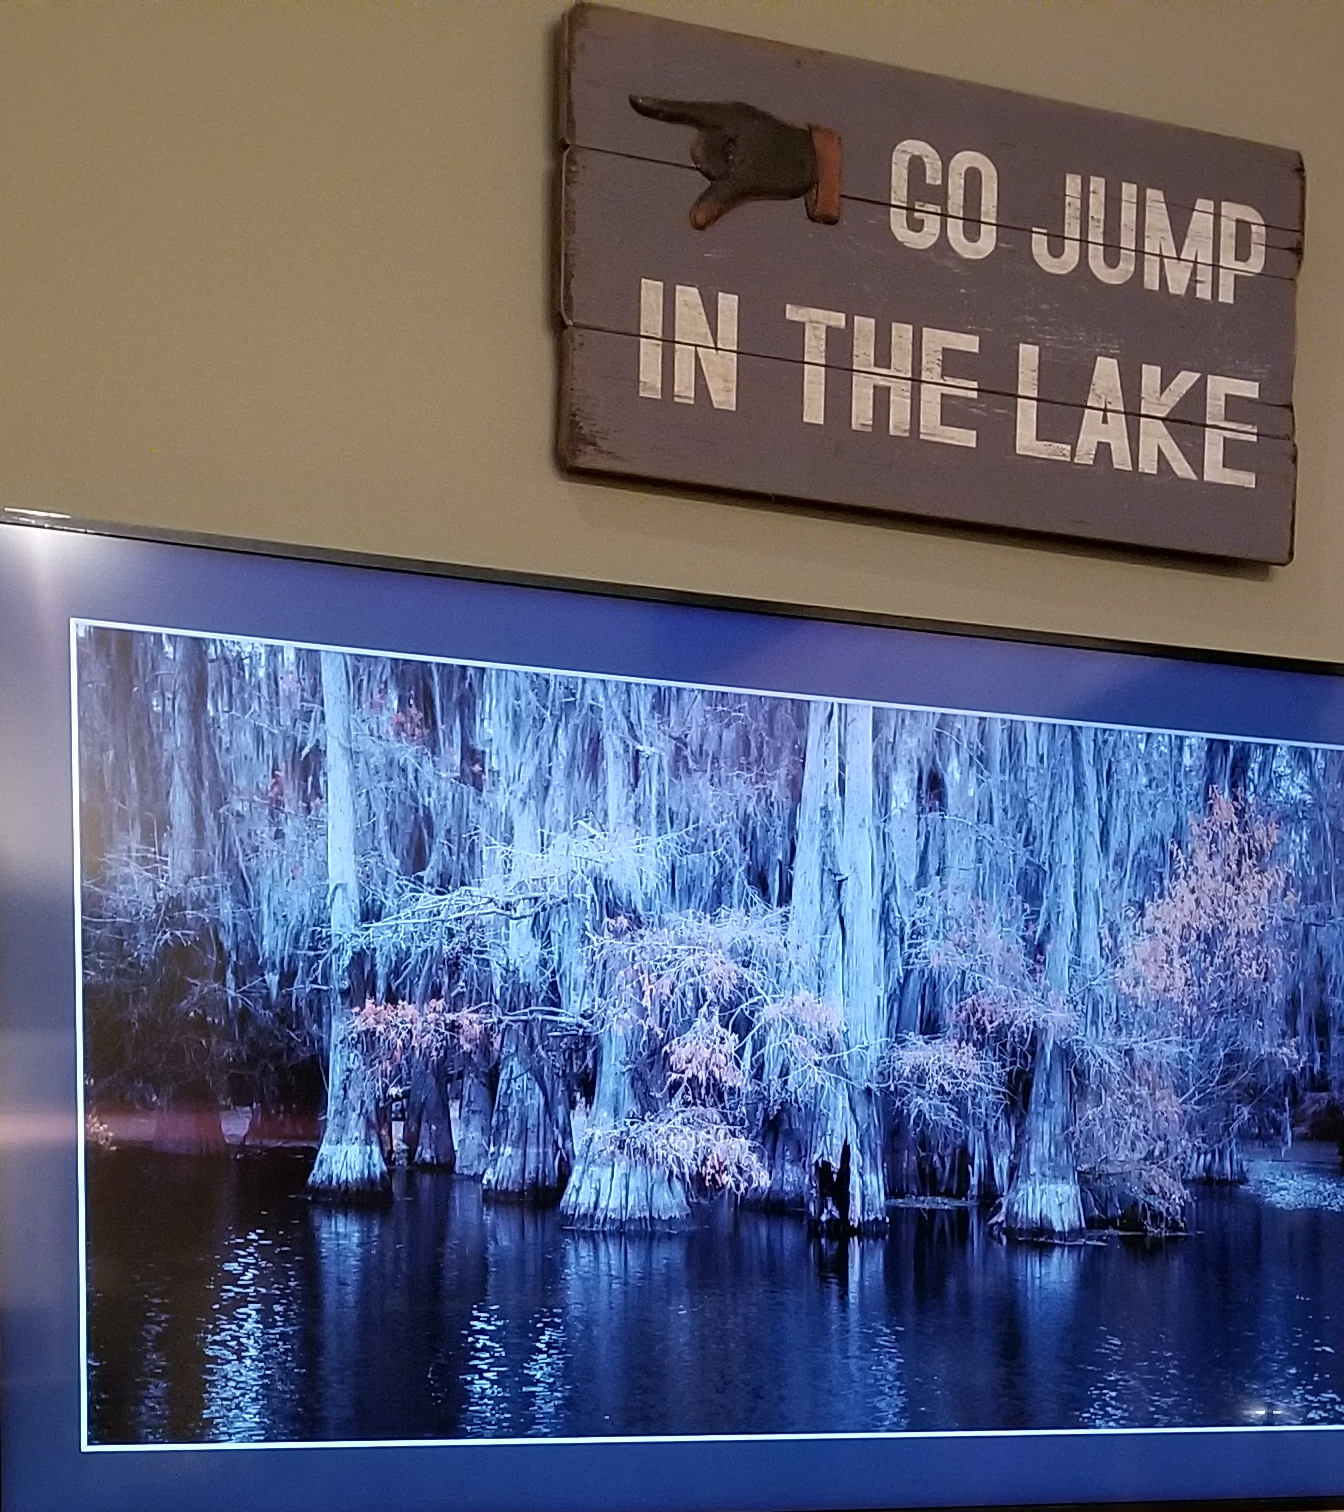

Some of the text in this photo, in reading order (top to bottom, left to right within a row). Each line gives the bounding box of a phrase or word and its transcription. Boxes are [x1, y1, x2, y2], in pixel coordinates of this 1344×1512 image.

[889, 138, 1267, 304] GO JUMP
[638, 277, 1260, 489] IN THE LAKE
